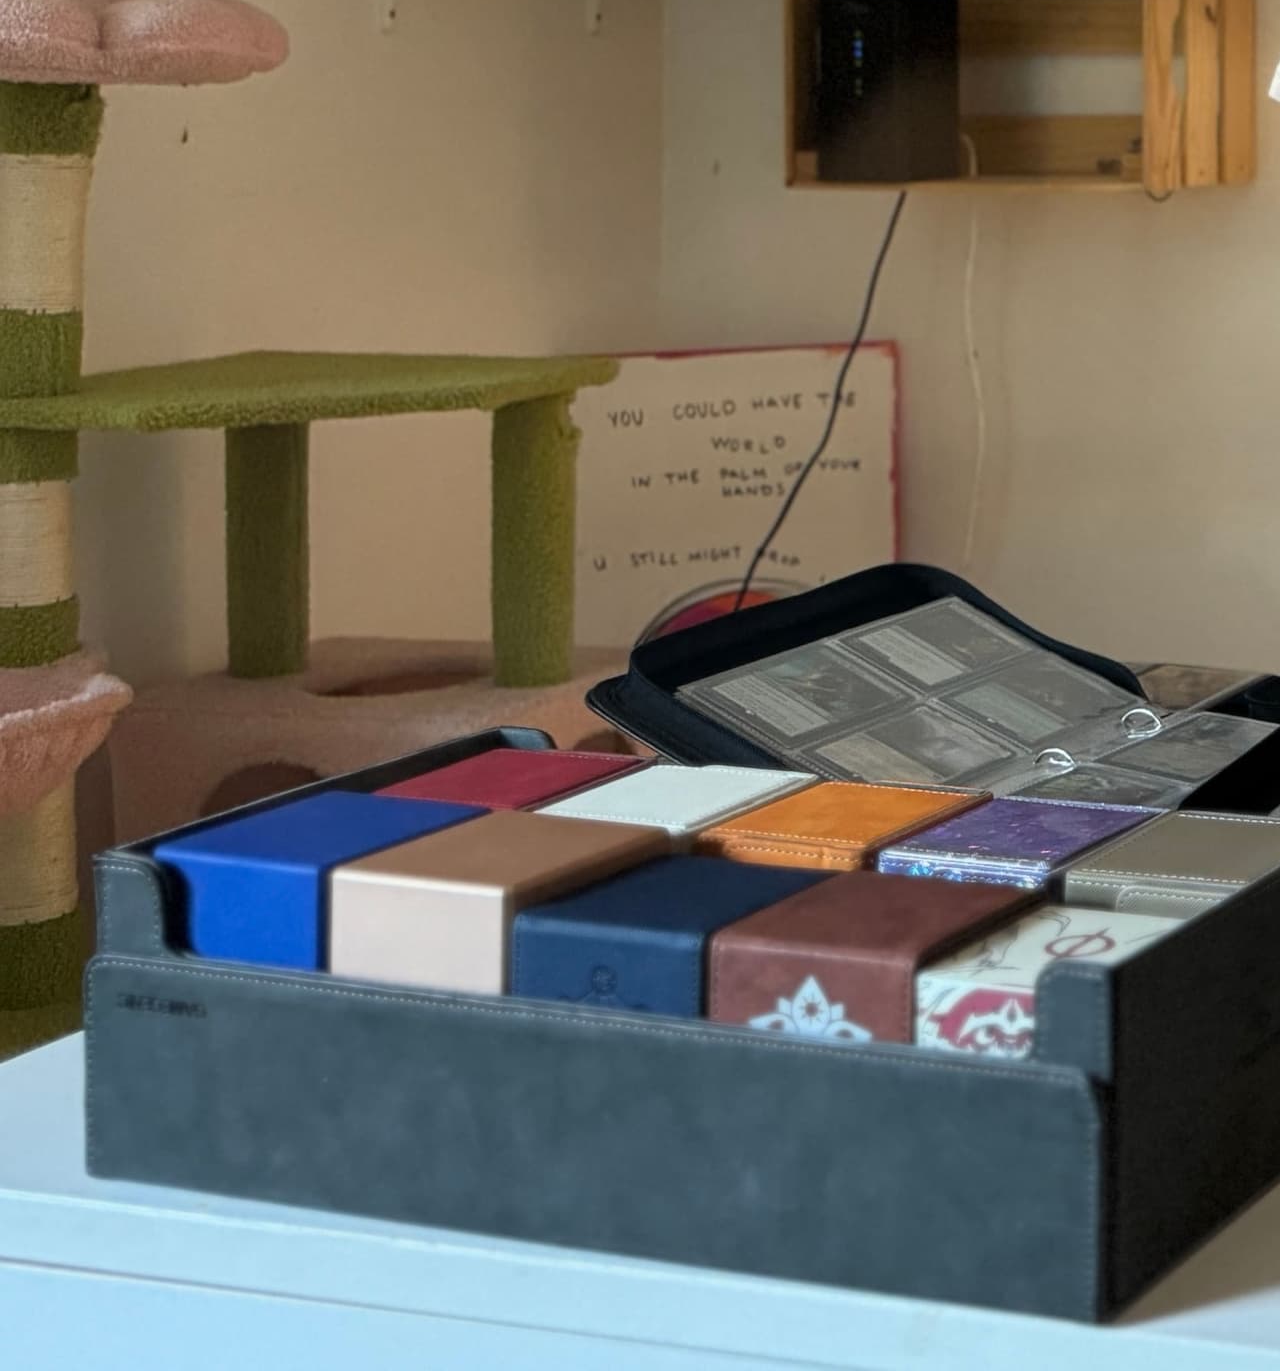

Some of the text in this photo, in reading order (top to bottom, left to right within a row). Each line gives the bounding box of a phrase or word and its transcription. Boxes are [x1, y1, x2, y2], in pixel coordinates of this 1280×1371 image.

[607, 390, 857, 428] YOU COULD HAVE TE
[710, 434, 786, 455] WORLD
[631, 475, 651, 489] IN
[663, 468, 700, 485] THE
[719, 466, 768, 483] PALM
[720, 482, 786, 499] HANDS
[593, 556, 607, 572] U
[630, 550, 679, 568] STILL
[688, 545, 742, 563] MIGHT
